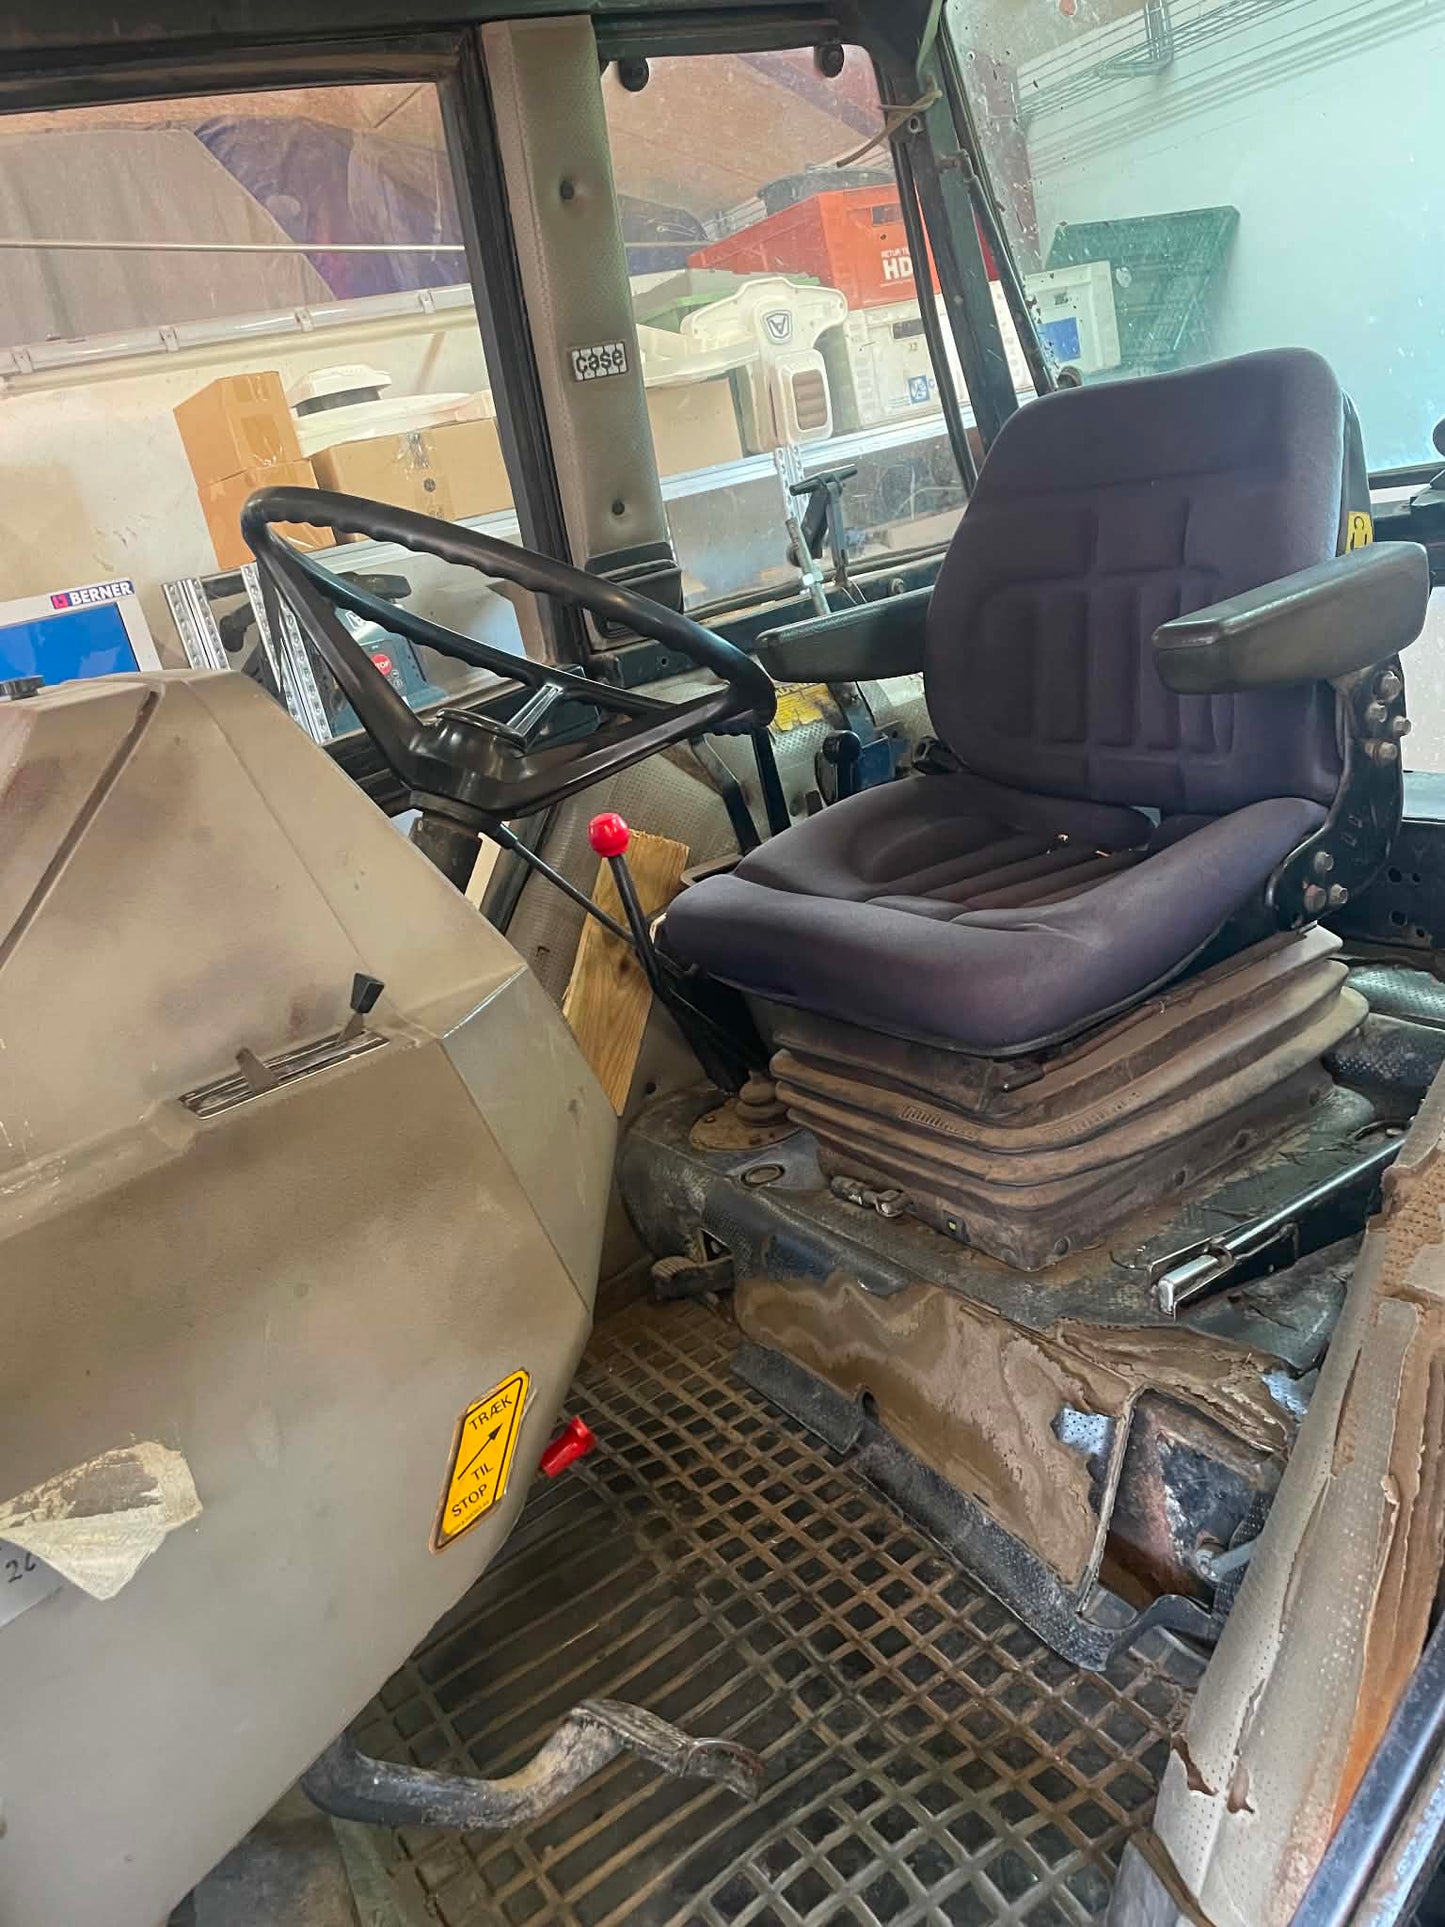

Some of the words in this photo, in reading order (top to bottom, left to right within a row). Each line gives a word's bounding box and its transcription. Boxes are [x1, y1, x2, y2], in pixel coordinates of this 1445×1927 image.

[576, 350, 623, 372] case
[69, 581, 133, 606] BERNER
[469, 1394, 513, 1431] TRÆK
[471, 1463, 494, 1482] TIL
[451, 1483, 488, 1517] STOP
